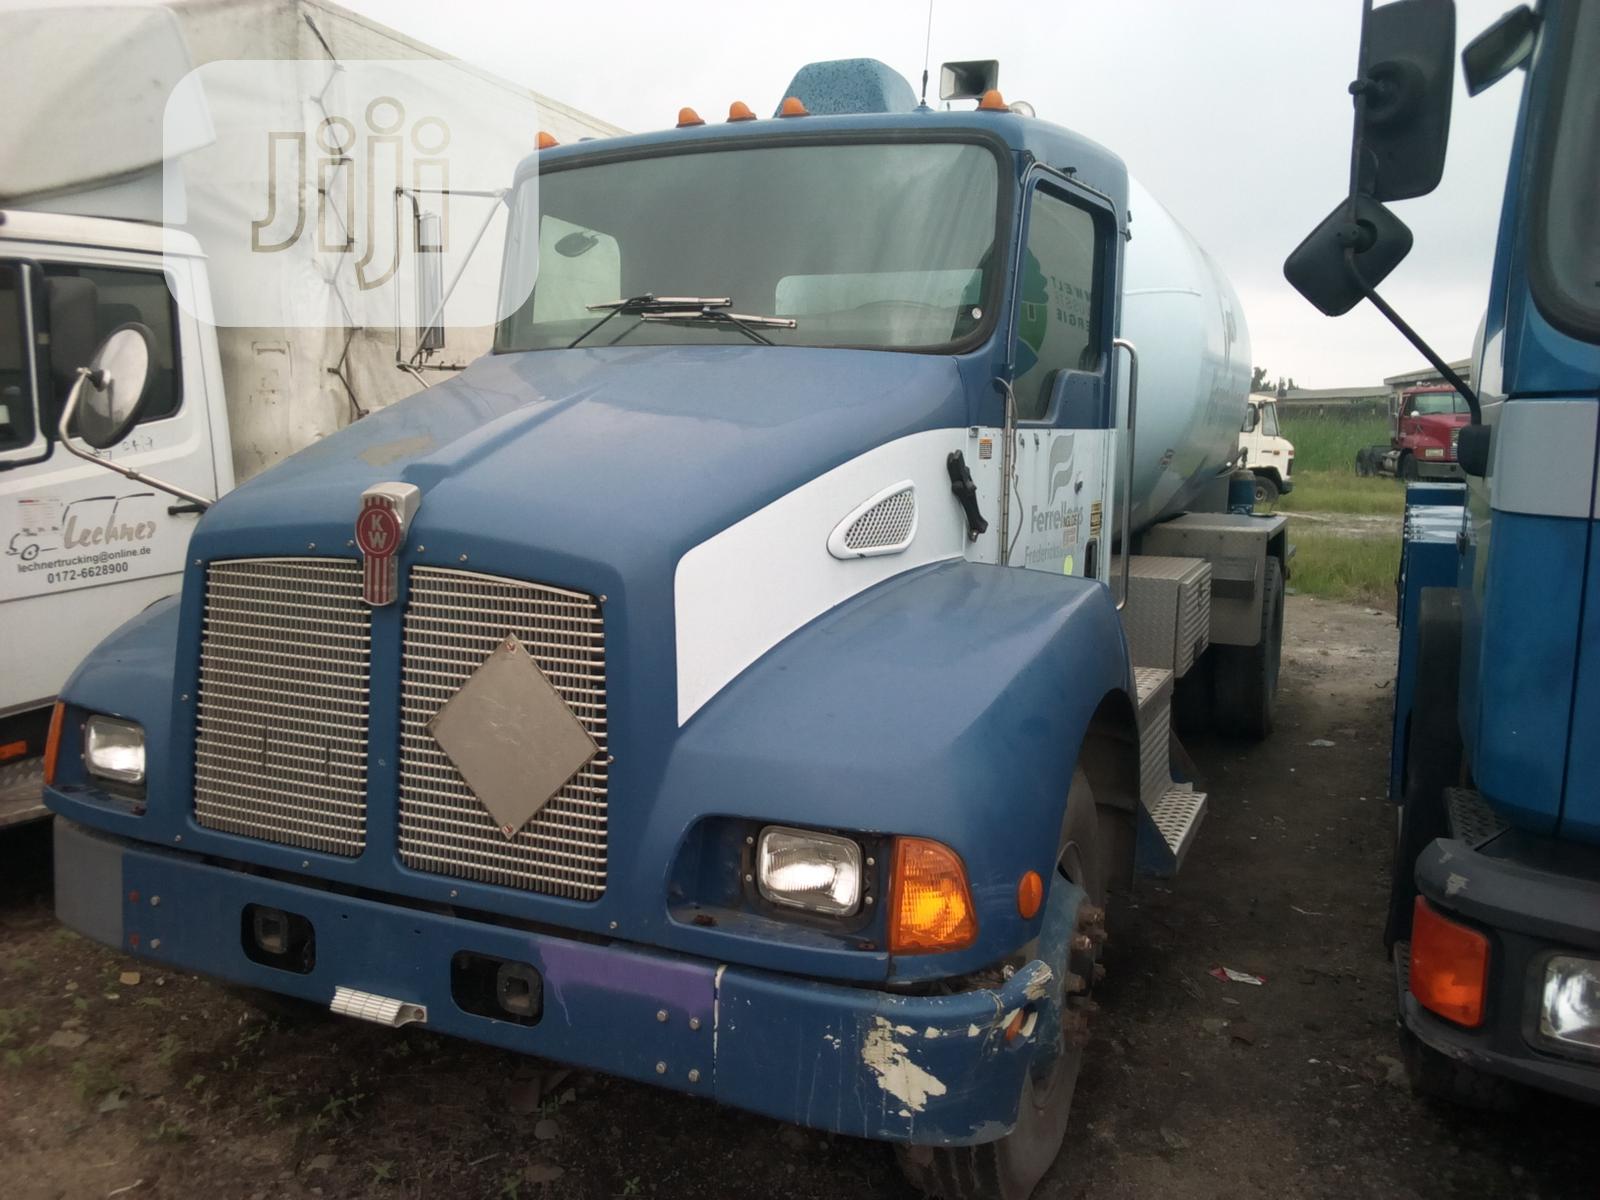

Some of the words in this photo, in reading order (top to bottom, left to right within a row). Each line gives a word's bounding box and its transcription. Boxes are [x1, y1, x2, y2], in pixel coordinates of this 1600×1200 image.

[64, 515, 157, 550] Lechner
[17, 546, 152, 573] lechnertrucking@online.de
[47, 562, 129, 584] 0172-6628900
